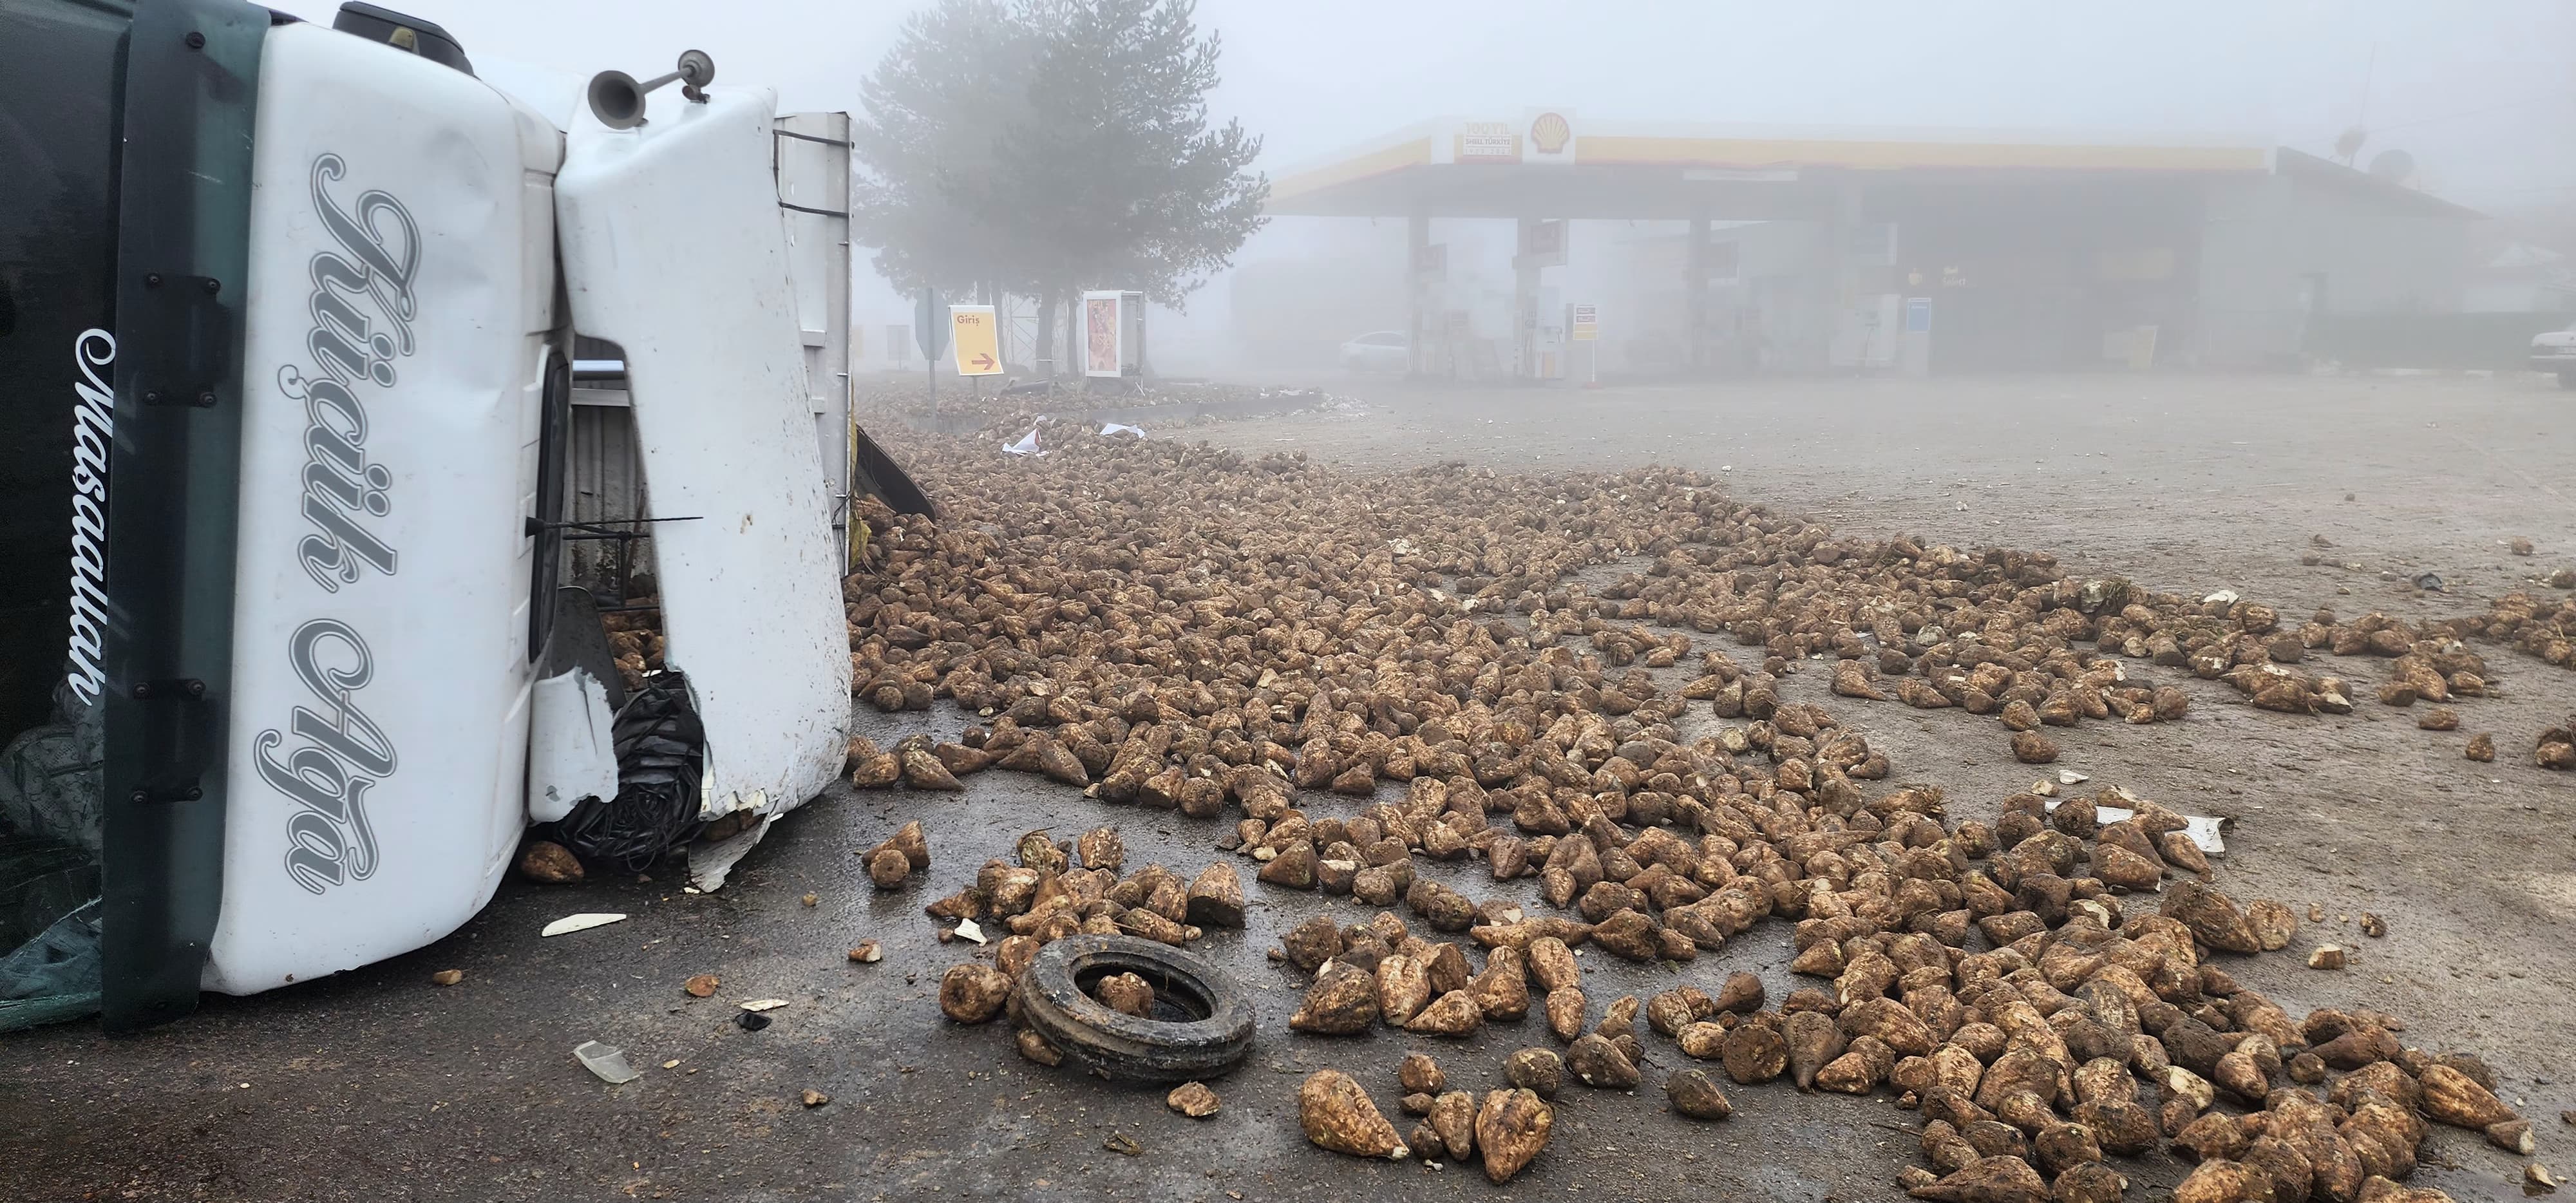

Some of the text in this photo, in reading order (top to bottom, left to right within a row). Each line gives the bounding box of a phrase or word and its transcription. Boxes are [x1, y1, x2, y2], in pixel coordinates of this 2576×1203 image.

[956, 315, 980, 327] Giriş
[253, 152, 422, 896] Küçük Ağa
